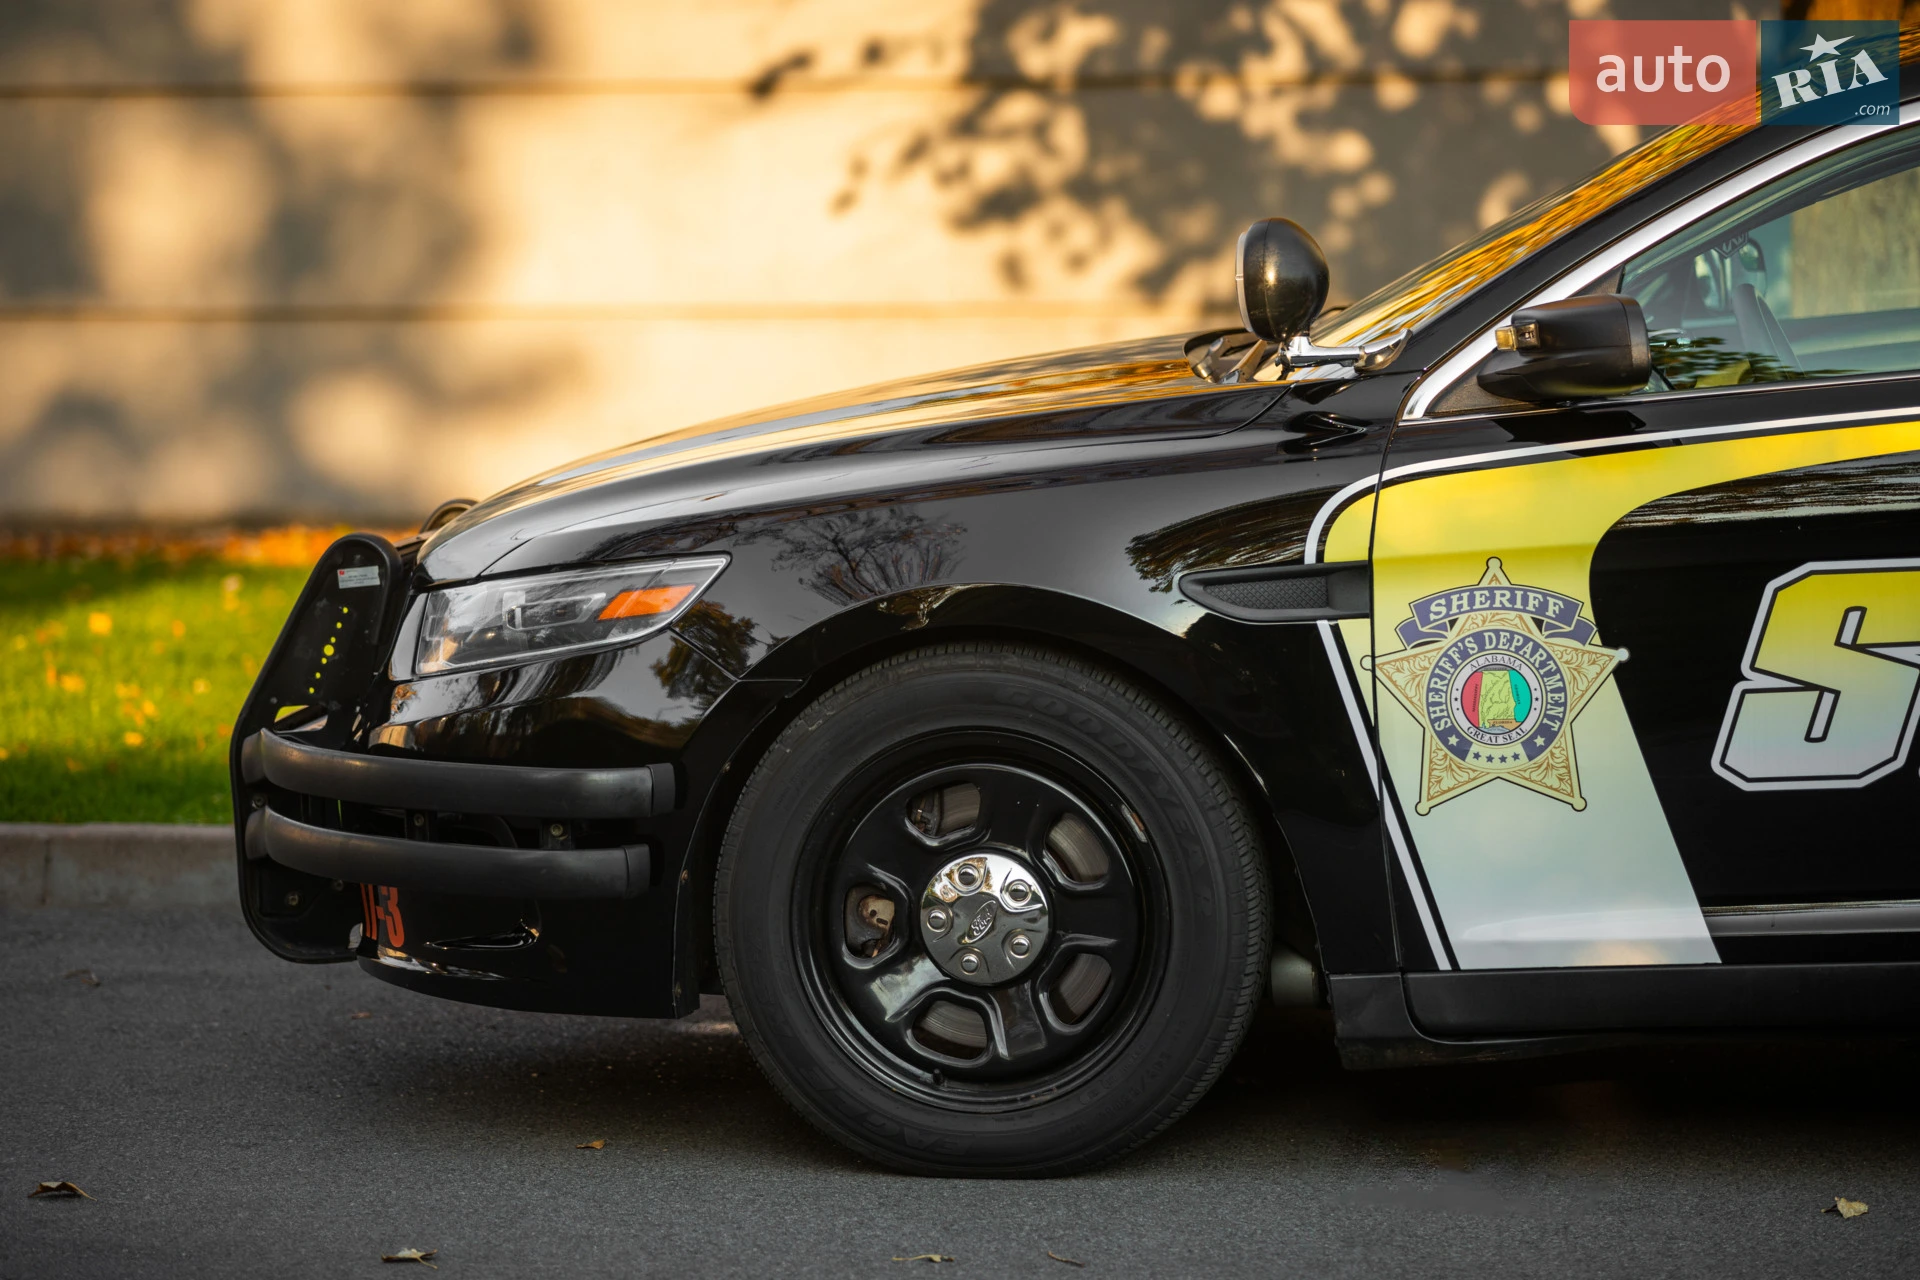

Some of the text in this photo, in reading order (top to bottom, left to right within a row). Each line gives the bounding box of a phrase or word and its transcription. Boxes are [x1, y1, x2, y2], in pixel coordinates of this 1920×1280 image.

[1429, 588, 1565, 622] SHERIFF
[1469, 655, 1523, 671] ALABAMA
[1428, 631, 1565, 732] SHERIFF'S DEPARTMENT
[1466, 726, 1528, 743] GREAT SEAL
